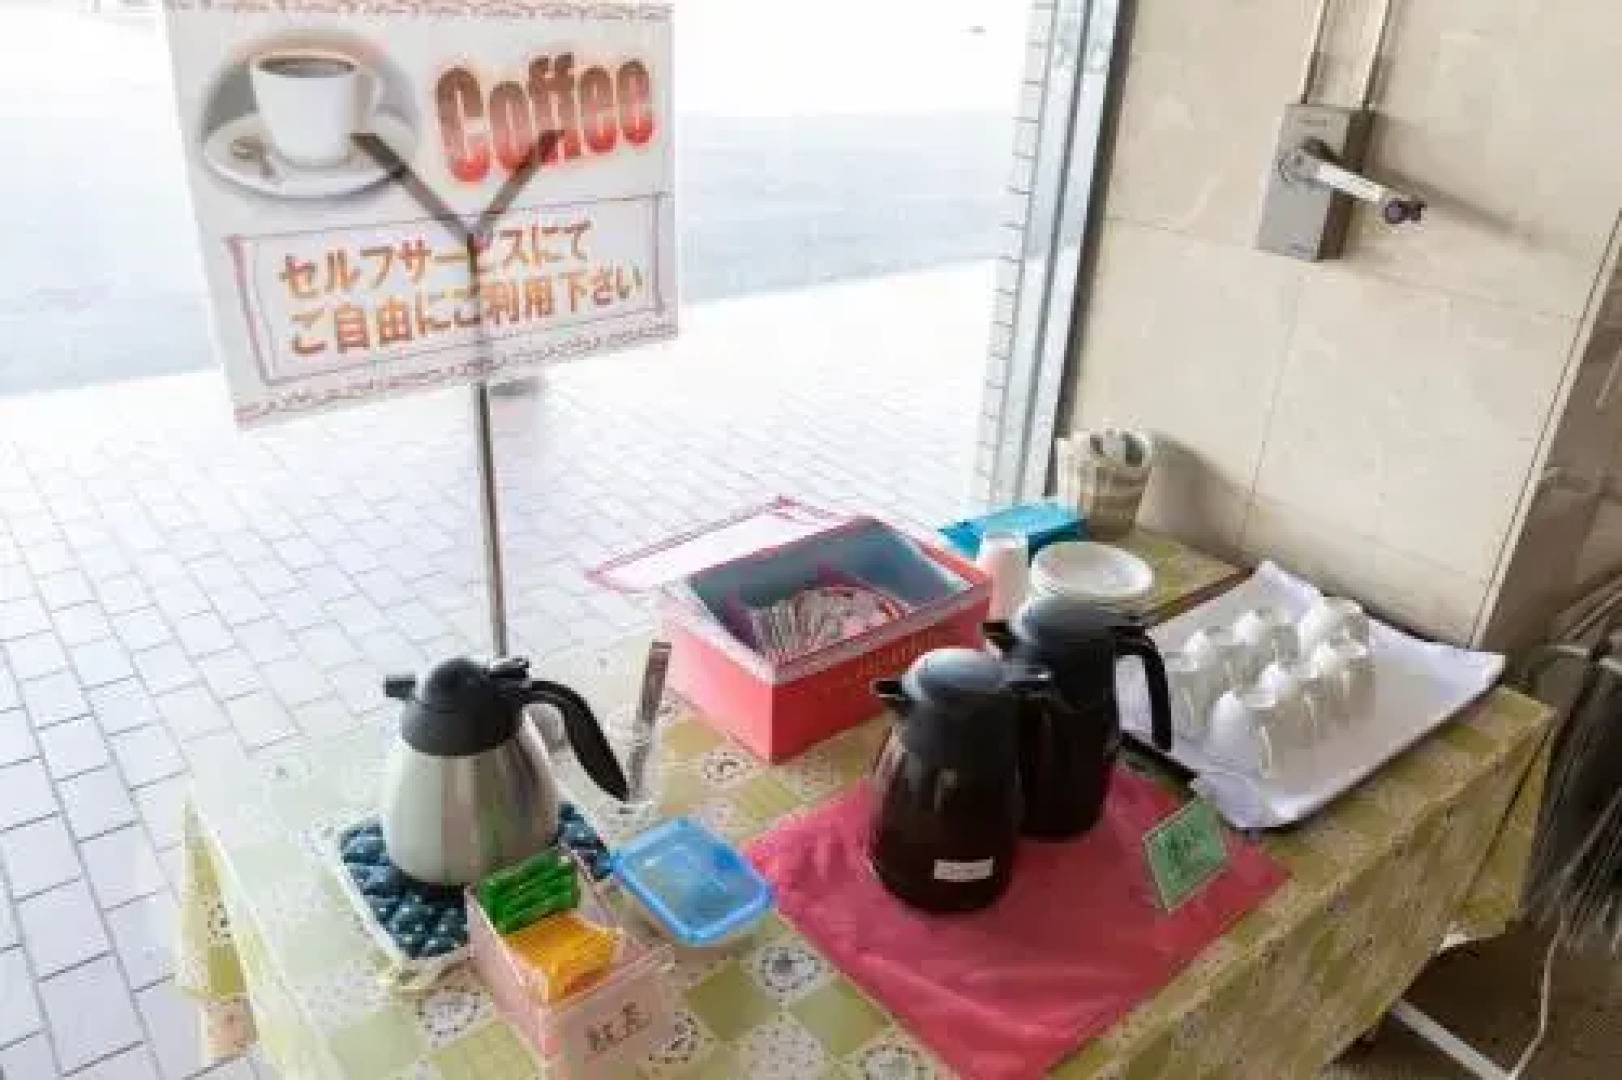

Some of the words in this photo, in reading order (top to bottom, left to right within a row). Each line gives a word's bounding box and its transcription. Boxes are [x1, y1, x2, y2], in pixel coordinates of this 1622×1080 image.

[436, 53, 655, 182] Coffee
[289, 264, 643, 355] ご自由にご利用下さい
